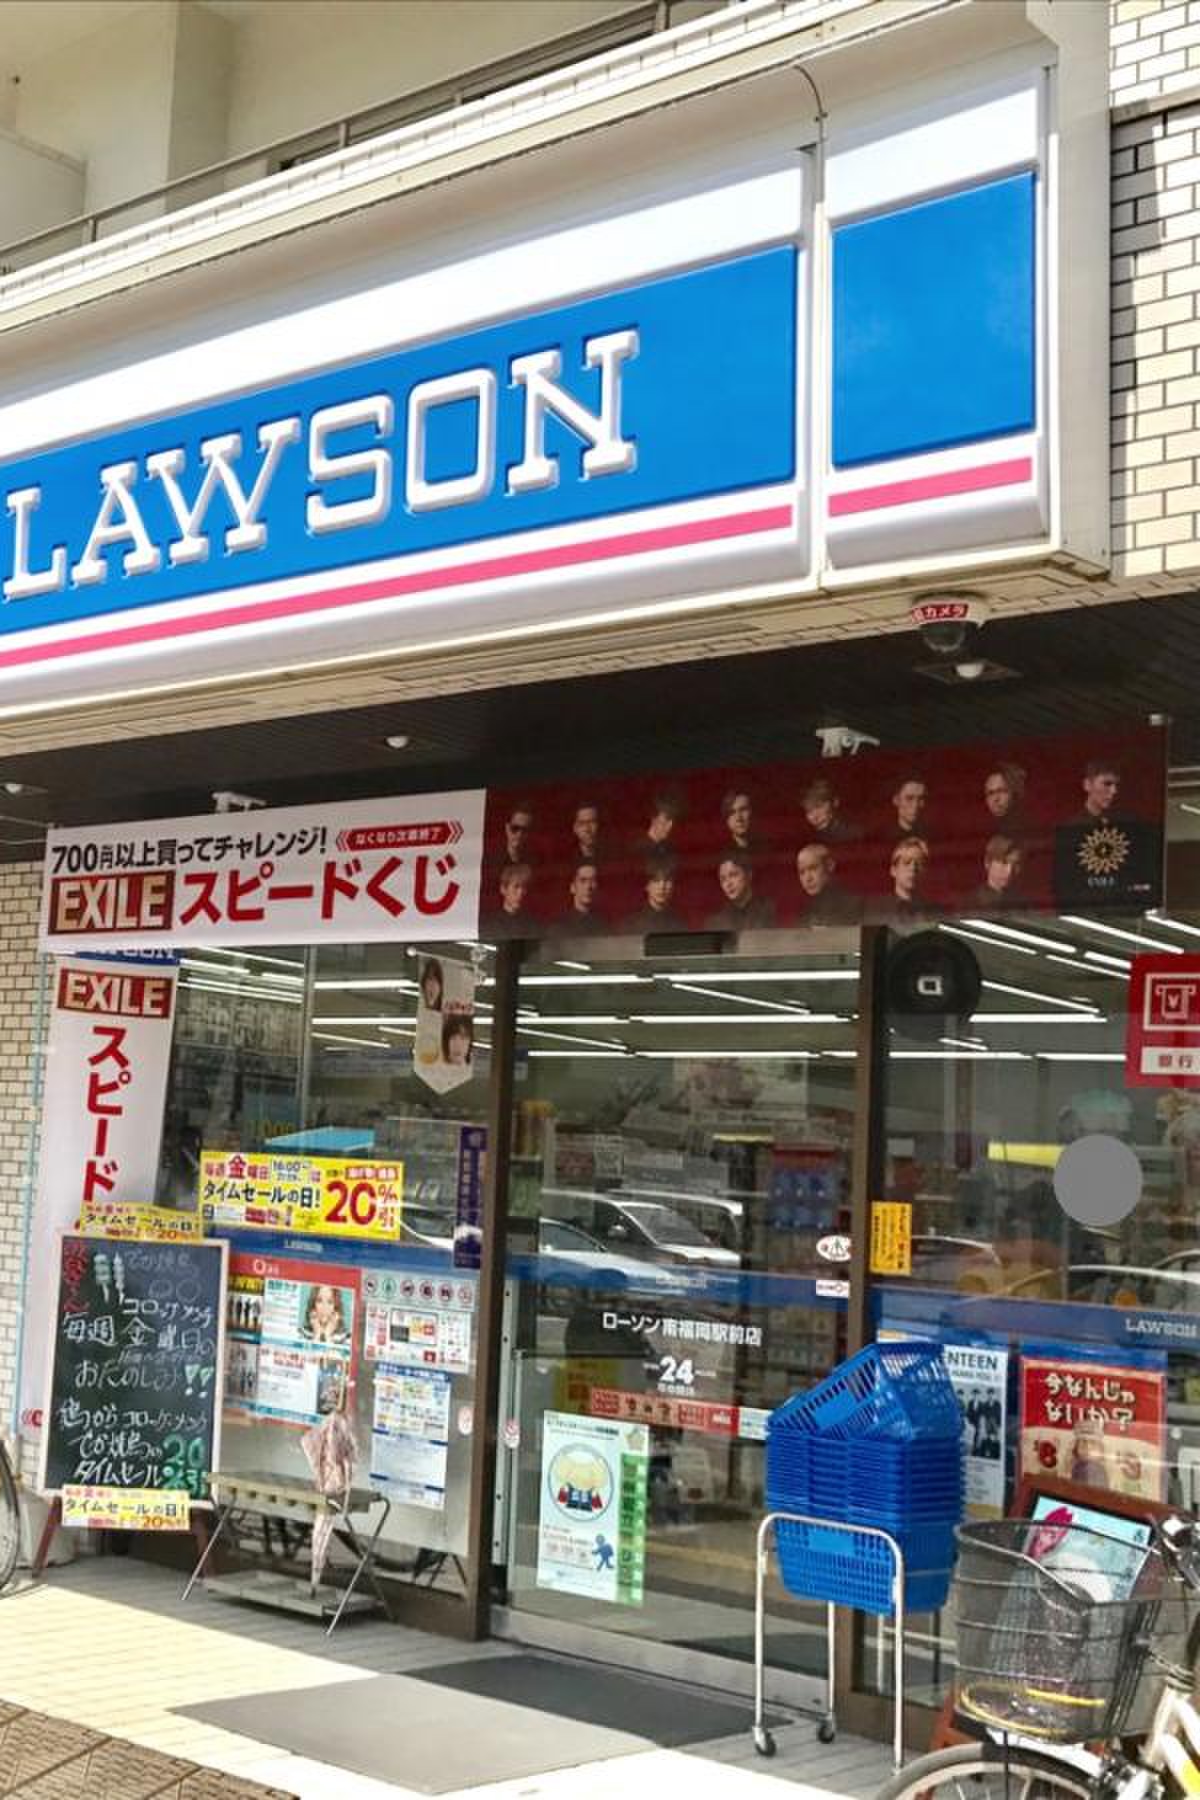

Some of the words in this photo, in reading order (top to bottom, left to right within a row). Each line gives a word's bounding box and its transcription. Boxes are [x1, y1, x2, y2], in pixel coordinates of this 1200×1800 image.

[2, 325, 640, 602] LAWSON
[51, 827, 327, 874] 700円以上買ってチャレンジ!
[55, 873, 168, 931] EXILE
[180, 854, 460, 925] スピードくじ
[64, 971, 165, 1016] EXILE
[203, 1180, 321, 1208] タイムセールの日!
[1125, 1318, 1198, 1337] LAWSON
[659, 1355, 695, 1385] 24
[1044, 1372, 1136, 1404] 今なんじゃ
[1044, 1401, 1134, 1431] ないか?
